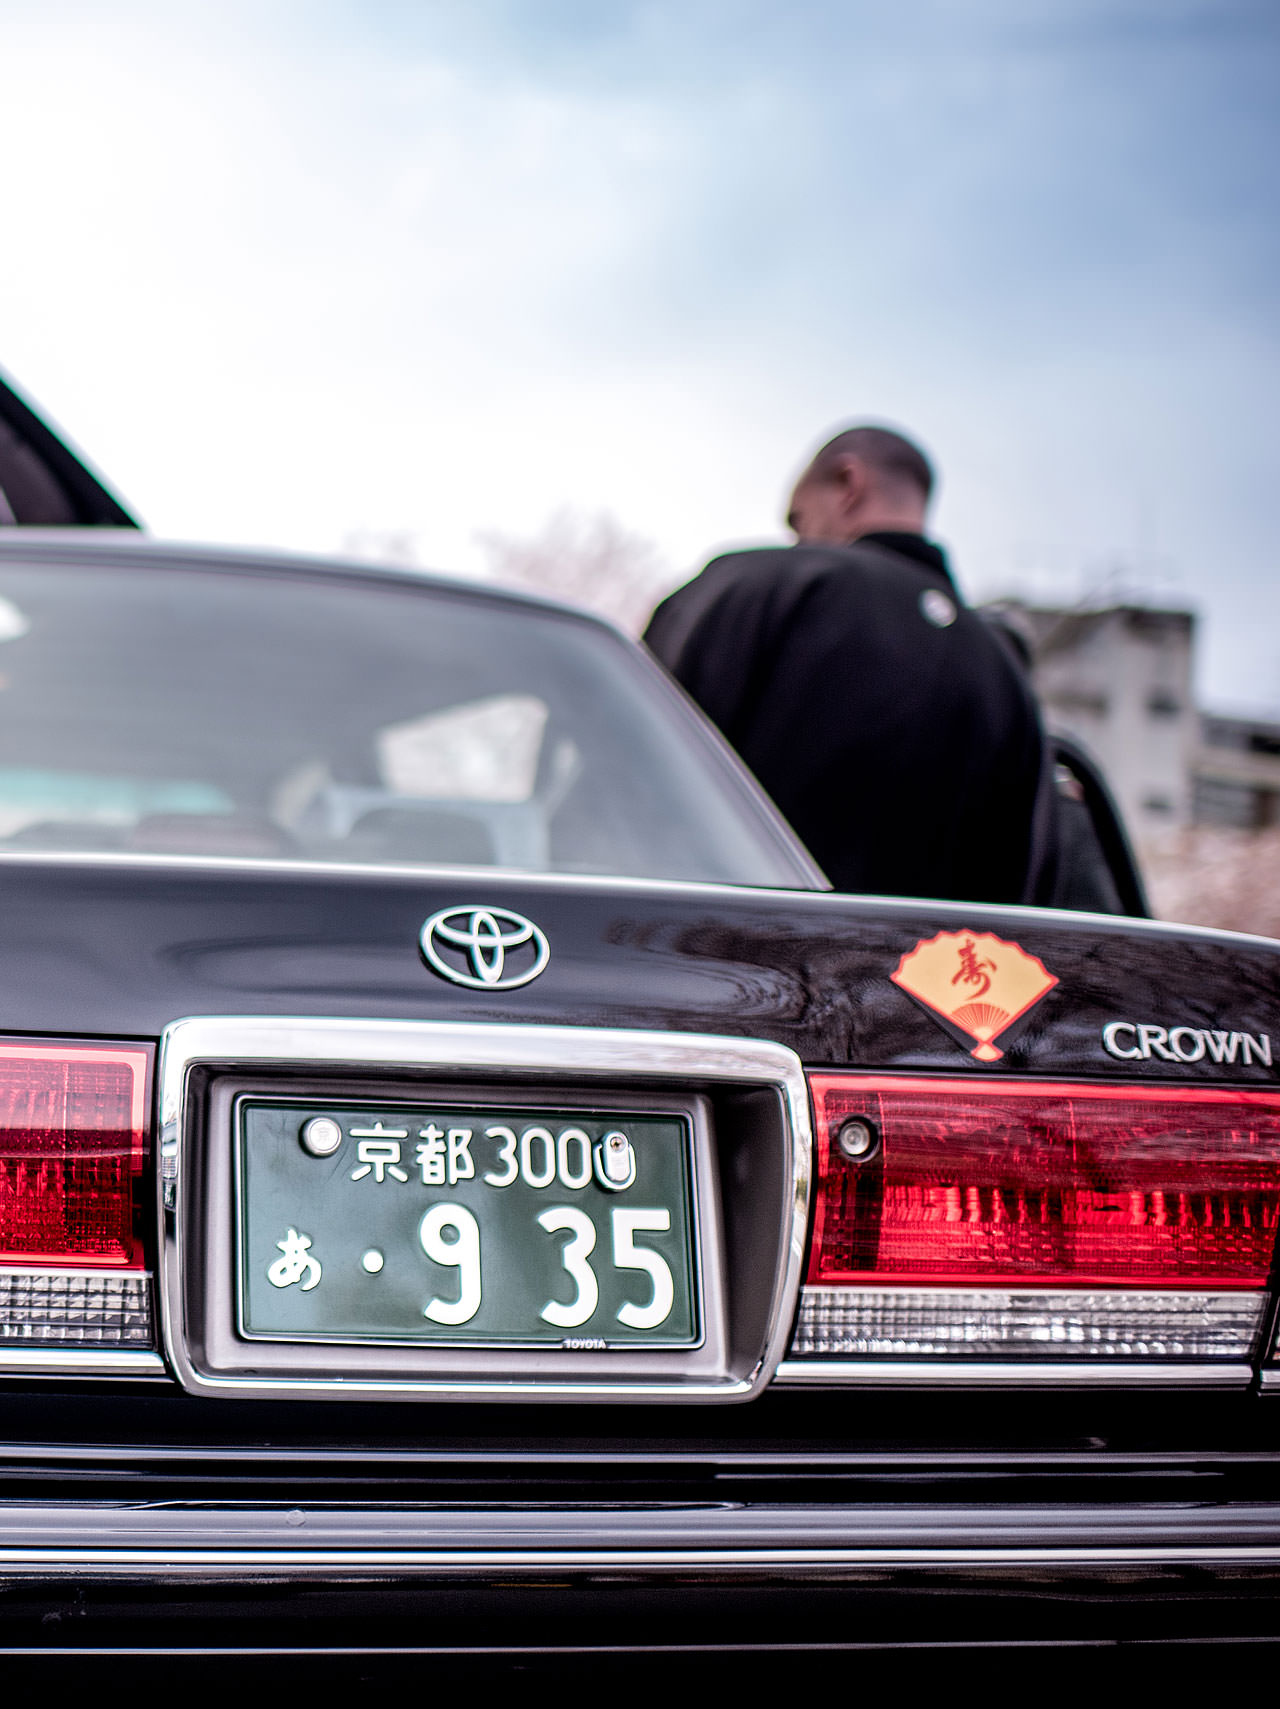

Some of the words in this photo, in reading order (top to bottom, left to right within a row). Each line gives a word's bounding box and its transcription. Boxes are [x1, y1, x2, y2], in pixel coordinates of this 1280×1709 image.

[1103, 1021, 1273, 1067] CROWN
[349, 1121, 476, 1185] 京都
[267, 1226, 322, 1291] あ
[562, 1337, 607, 1349] TOYOTA
